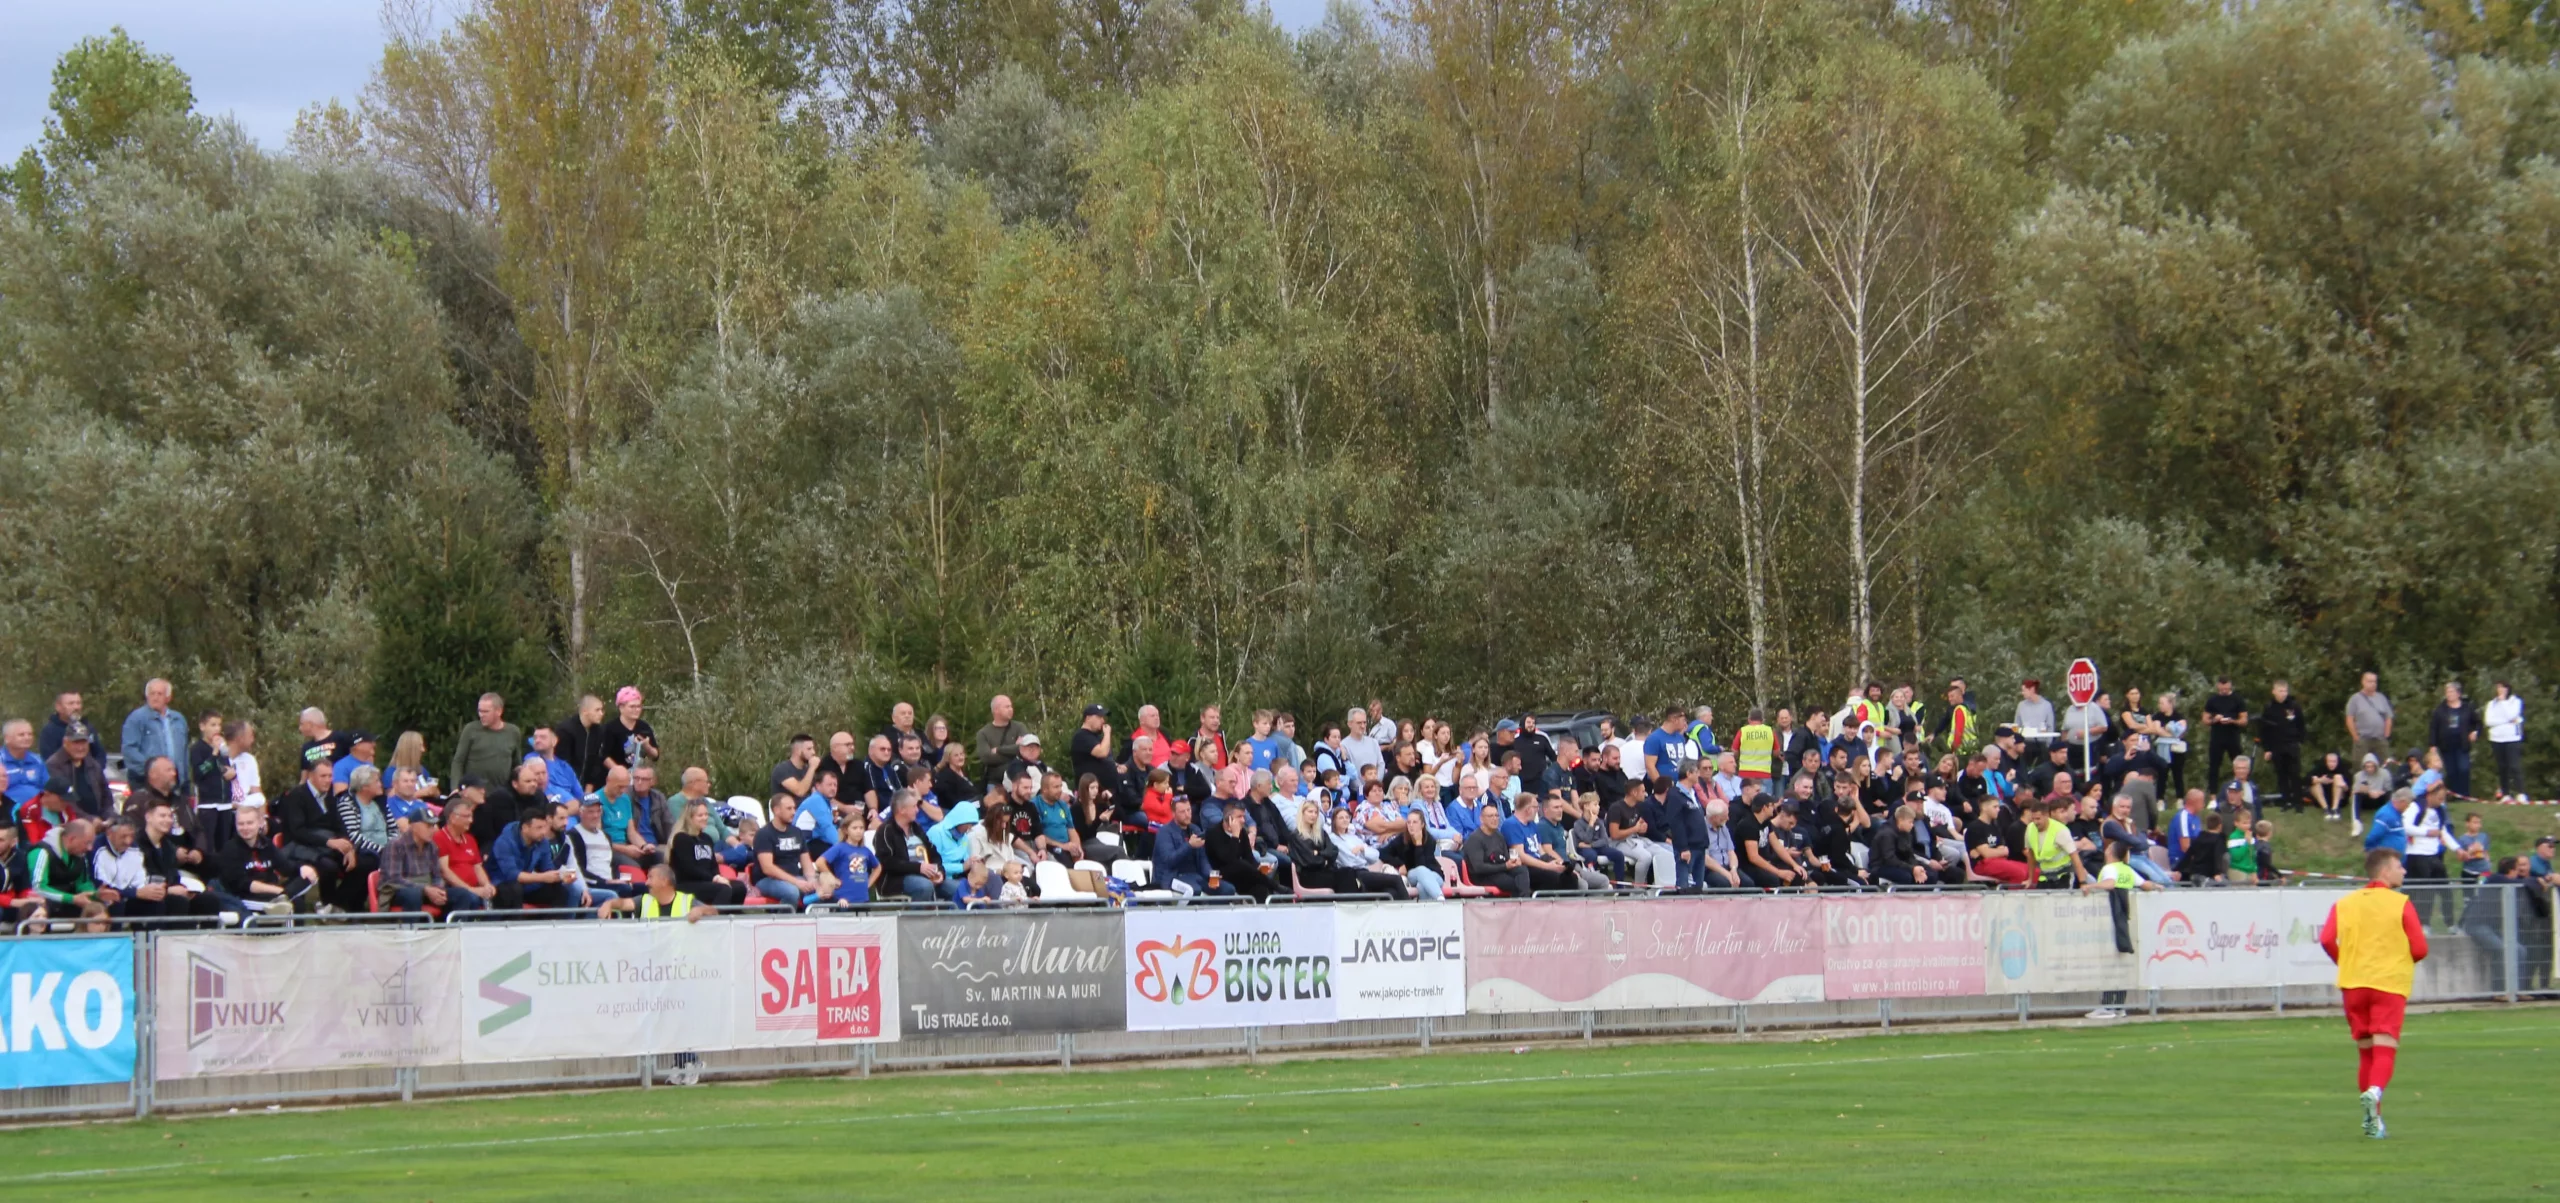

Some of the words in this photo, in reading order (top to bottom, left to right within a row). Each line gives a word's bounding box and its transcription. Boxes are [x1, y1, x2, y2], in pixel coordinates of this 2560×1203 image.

[2069, 672, 2094, 692] STOP
[1746, 730, 1769, 741] REDAR
[1825, 902, 1924, 945] Kontrol
[922, 925, 972, 960] caffe
[976, 925, 1011, 949] bar
[1003, 921, 1119, 976] Mura
[1224, 931, 1281, 955] ULJARA
[1341, 929, 1461, 964] JAKOPIĆ
[1646, 918, 1691, 960] Sveti
[1683, 918, 1744, 961] Martin
[1761, 917, 1807, 959] Muri
[2207, 921, 2241, 962] Super
[537, 959, 610, 986] SLIKA
[616, 956, 688, 983] Padarić
[689, 965, 722, 979] d.o.o.
[1863, 958, 1873, 969] za
[1224, 955, 1331, 1002] BISTER
[1852, 978, 1960, 992] www.kontrolbiro.hr
[991, 985, 1041, 1001] MARTIN
[1047, 985, 1067, 999] NA
[1071, 984, 1101, 999] MURI
[1359, 985, 1444, 1000] www.jakopic-travel.hr
[0, 971, 123, 1053] KO
[214, 1001, 285, 1027] VNUK
[357, 1005, 424, 1027] VNUK
[596, 1003, 609, 1014] za
[612, 997, 685, 1017] graditeljstvo
[826, 1005, 870, 1023] TRANS
[850, 1025, 870, 1035] d.o.o.
[942, 1013, 979, 1028] TRADE
[982, 1011, 1012, 1026] d.o.o.
